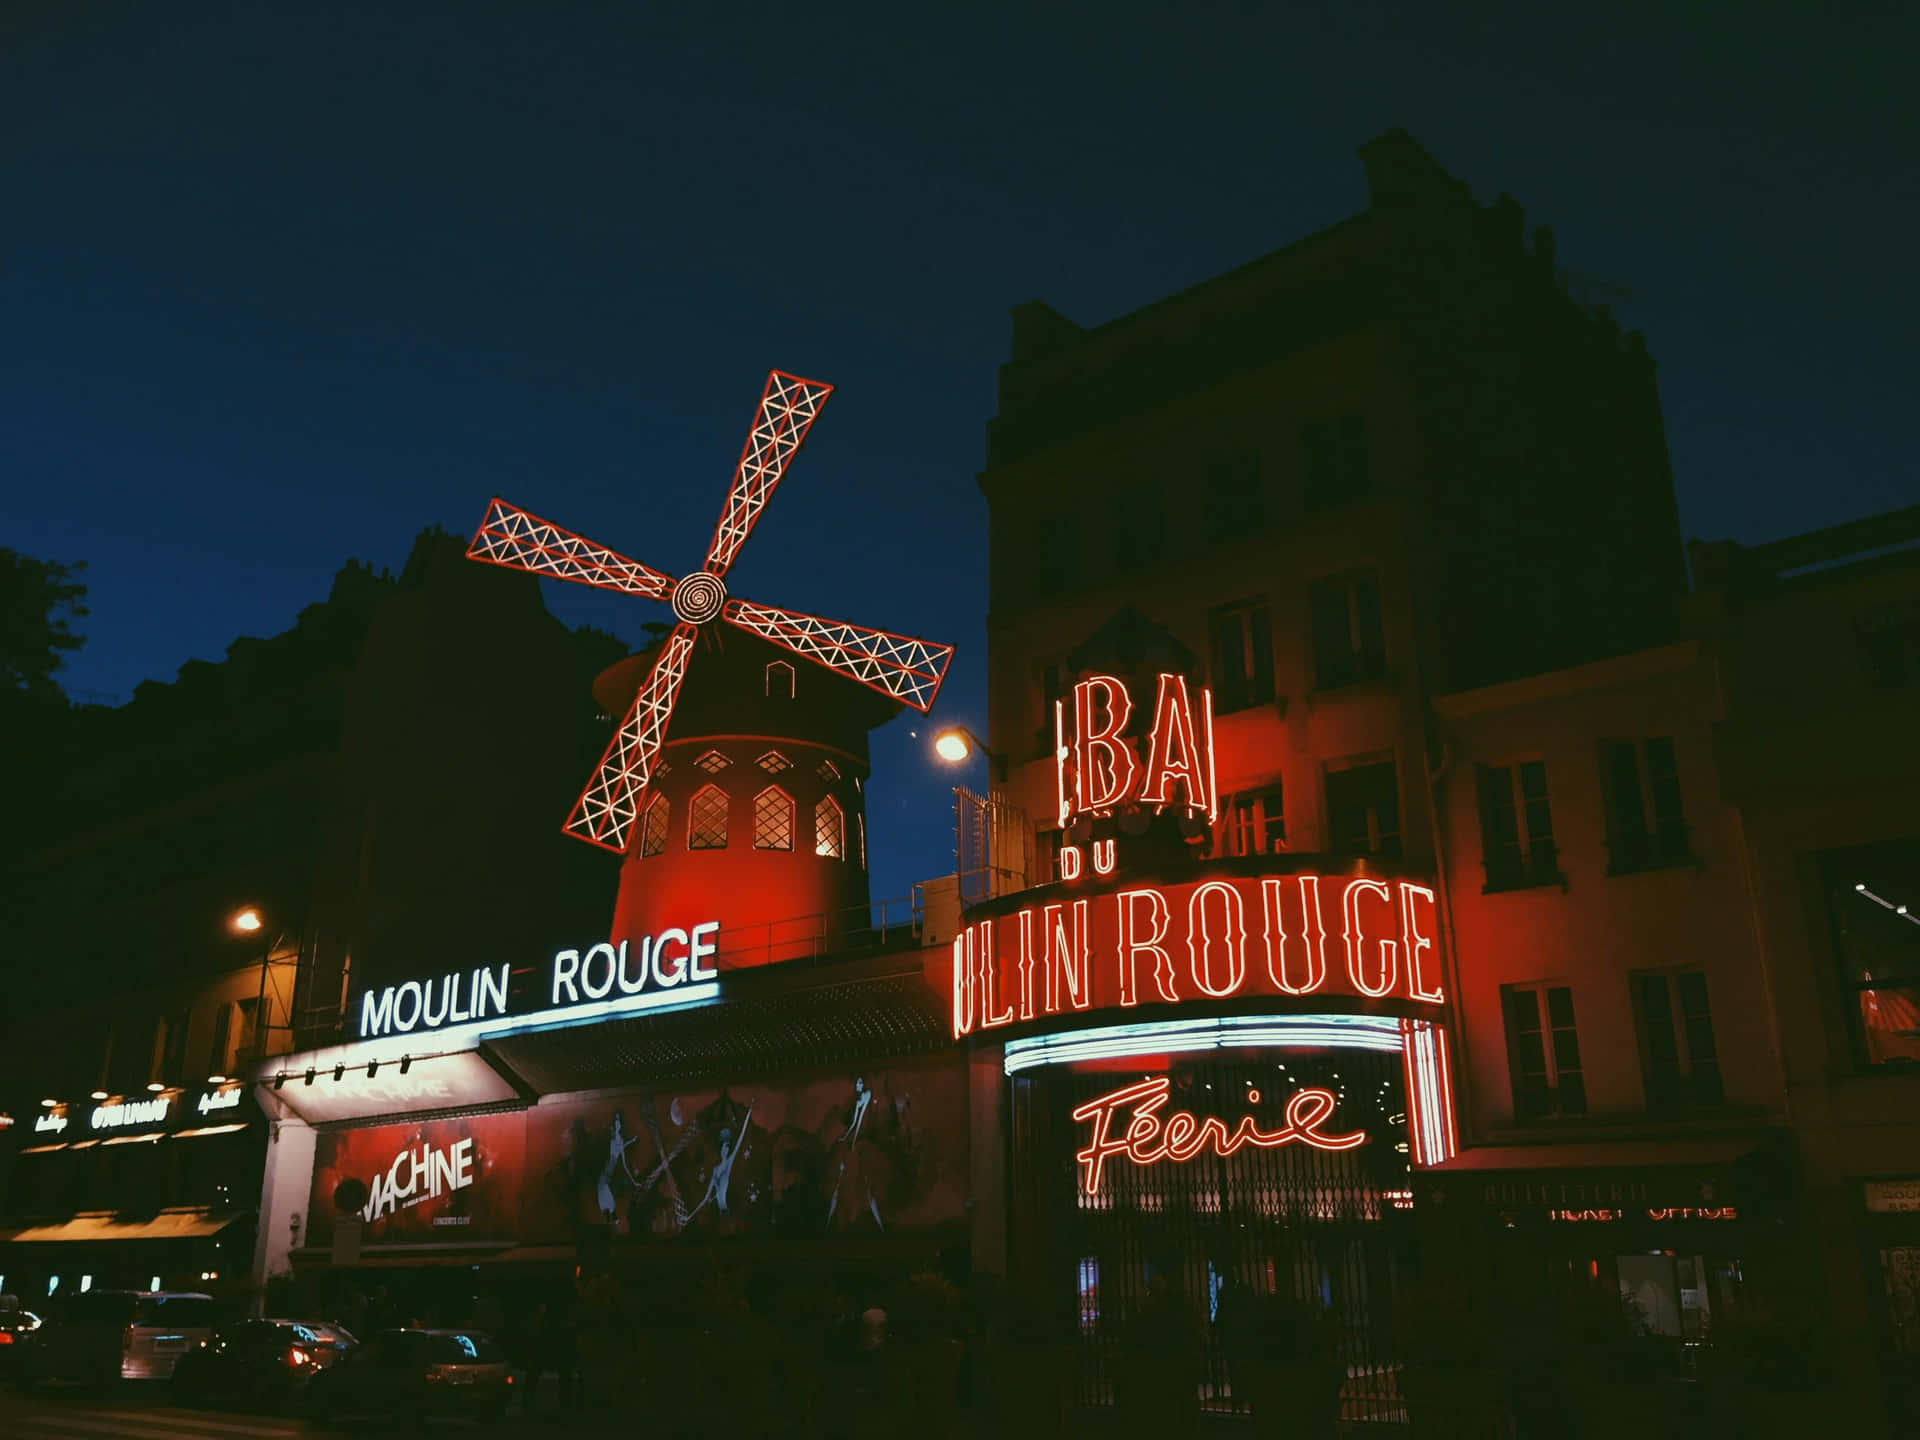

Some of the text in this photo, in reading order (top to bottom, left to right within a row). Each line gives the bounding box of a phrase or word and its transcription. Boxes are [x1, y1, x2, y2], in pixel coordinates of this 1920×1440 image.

[1061, 840, 1114, 880] DU
[360, 921, 720, 1037] MOULIN ROUGE
[1116, 876, 1445, 1006] ROUGE
[1073, 1077, 1366, 1194] Féerie
